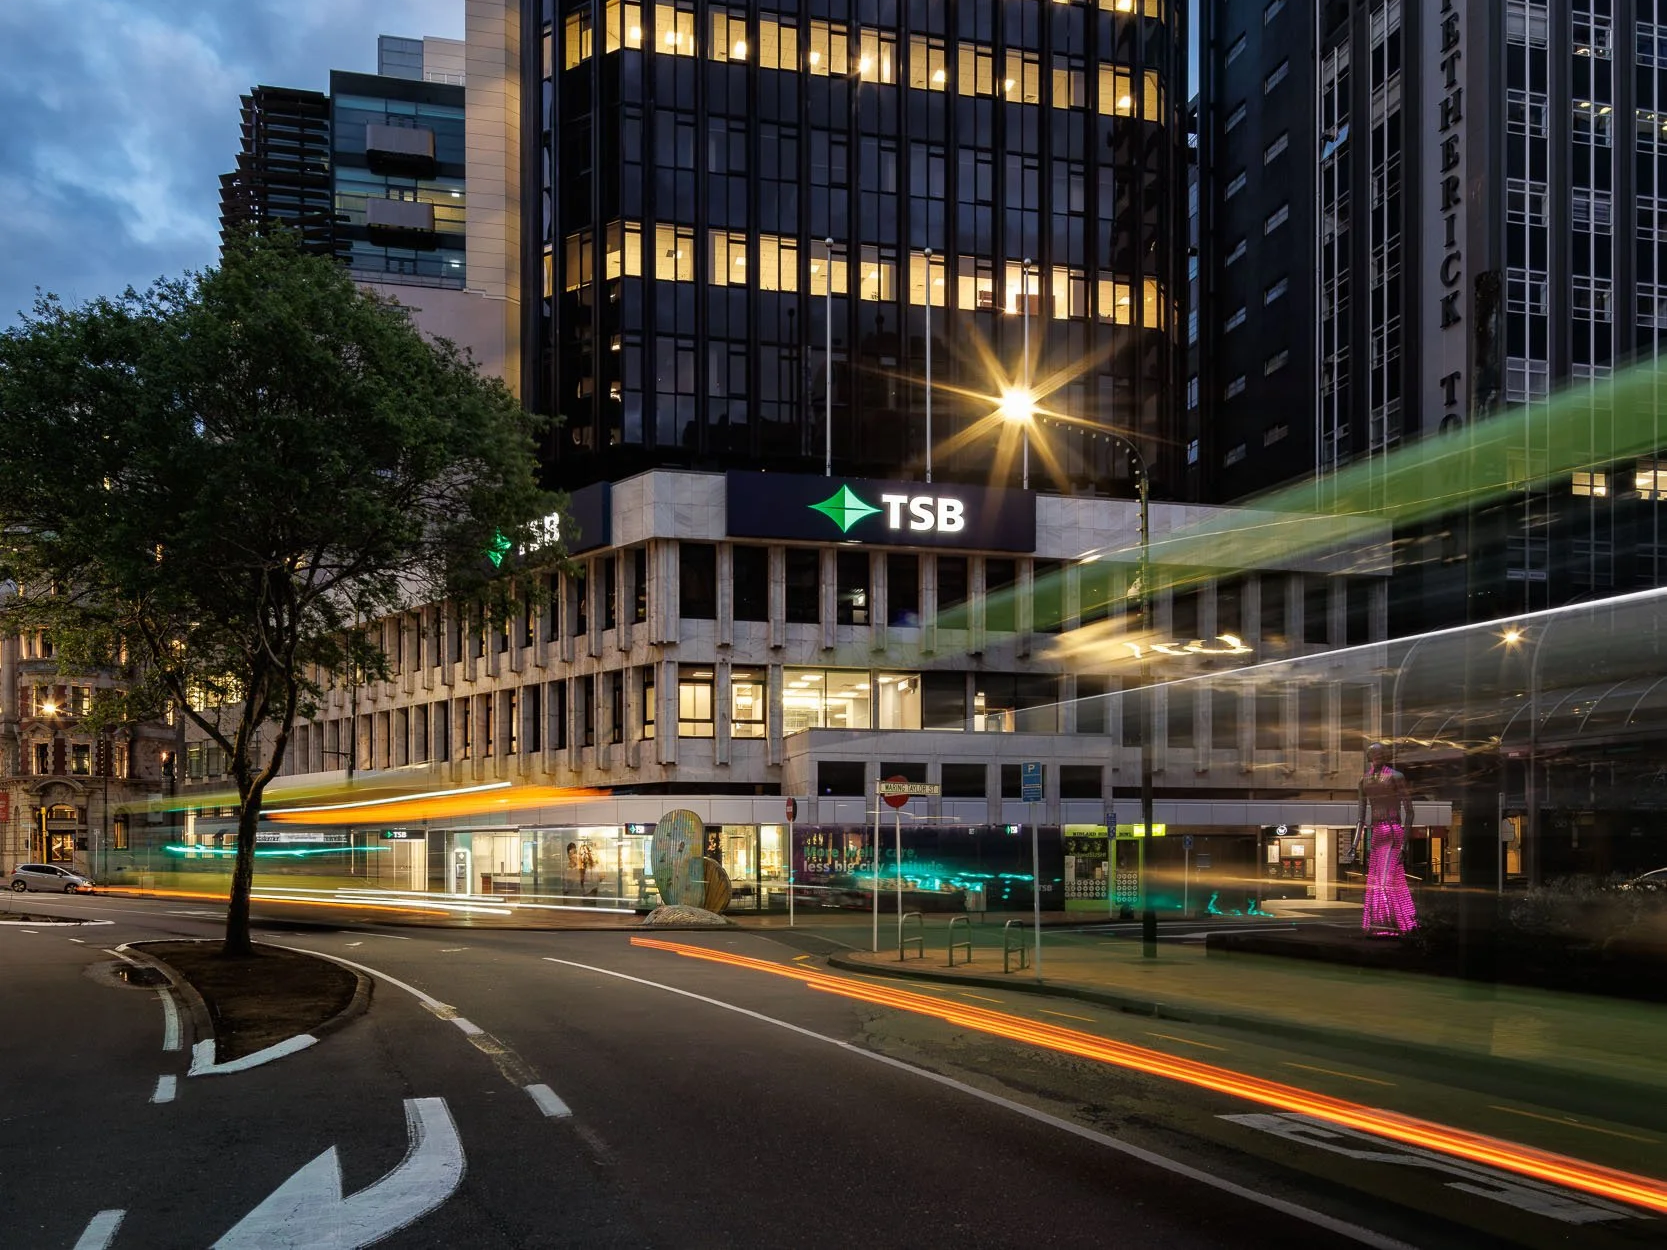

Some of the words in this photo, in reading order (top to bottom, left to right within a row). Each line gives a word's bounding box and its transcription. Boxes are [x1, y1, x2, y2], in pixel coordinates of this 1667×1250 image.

[882, 494, 965, 532] TSB
[907, 784, 927, 793] TAYLOR
[804, 846, 839, 859] More
[803, 860, 830, 872] less
[834, 860, 855, 875] big
[859, 860, 884, 875] city
